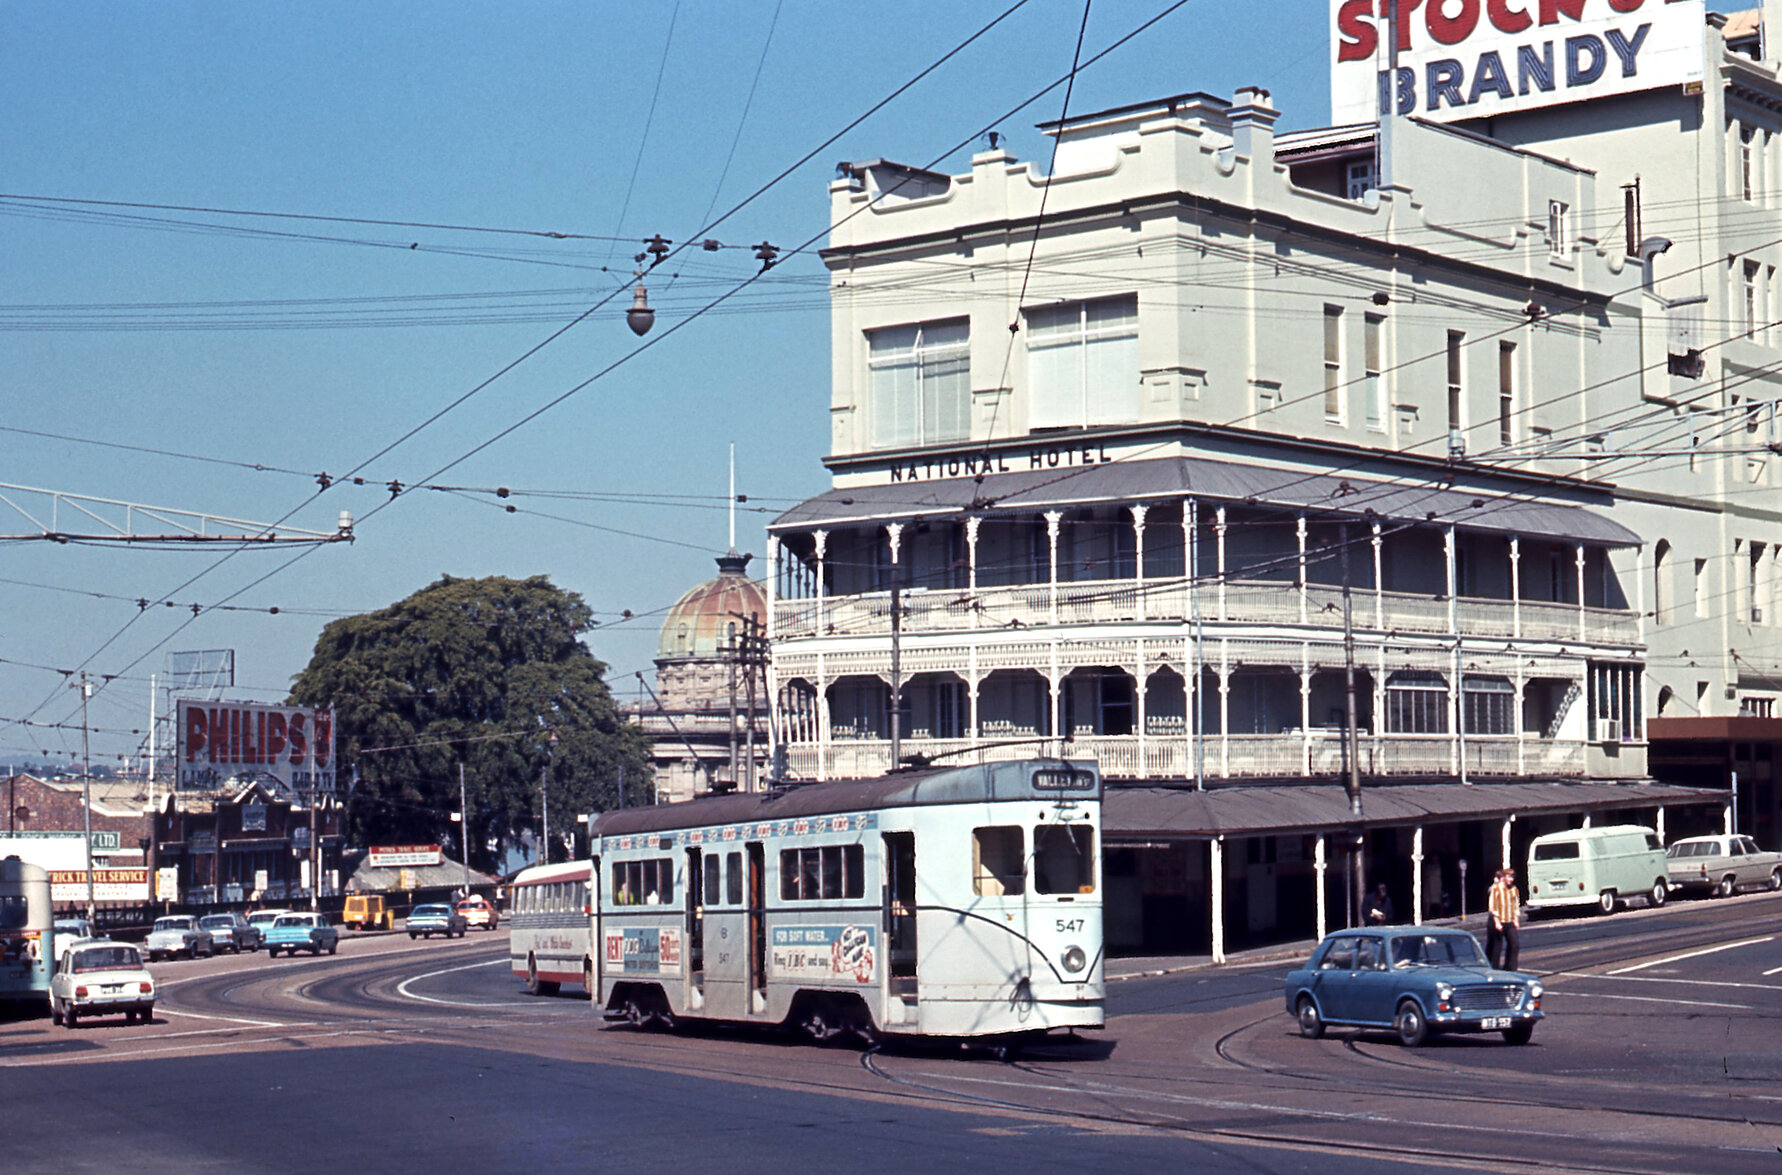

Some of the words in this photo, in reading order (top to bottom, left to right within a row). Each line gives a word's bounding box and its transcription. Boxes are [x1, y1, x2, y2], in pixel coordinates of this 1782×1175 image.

[1378, 22, 1652, 116] BRANDY
[891, 454, 1009, 482] NATIONAL
[1030, 445, 1111, 469] HOTEL
[186, 706, 307, 766] PHILIPS
[75, 871, 107, 882] TRVEL
[109, 870, 145, 882] SERVICE
[1056, 919, 1085, 933] 547
[776, 930, 787, 943] FOR
[789, 930, 804, 942] SOFT
[606, 936, 624, 960] RENT
[718, 952, 730, 965] 547
[773, 952, 786, 970] Ring
[807, 953, 817, 967] and
